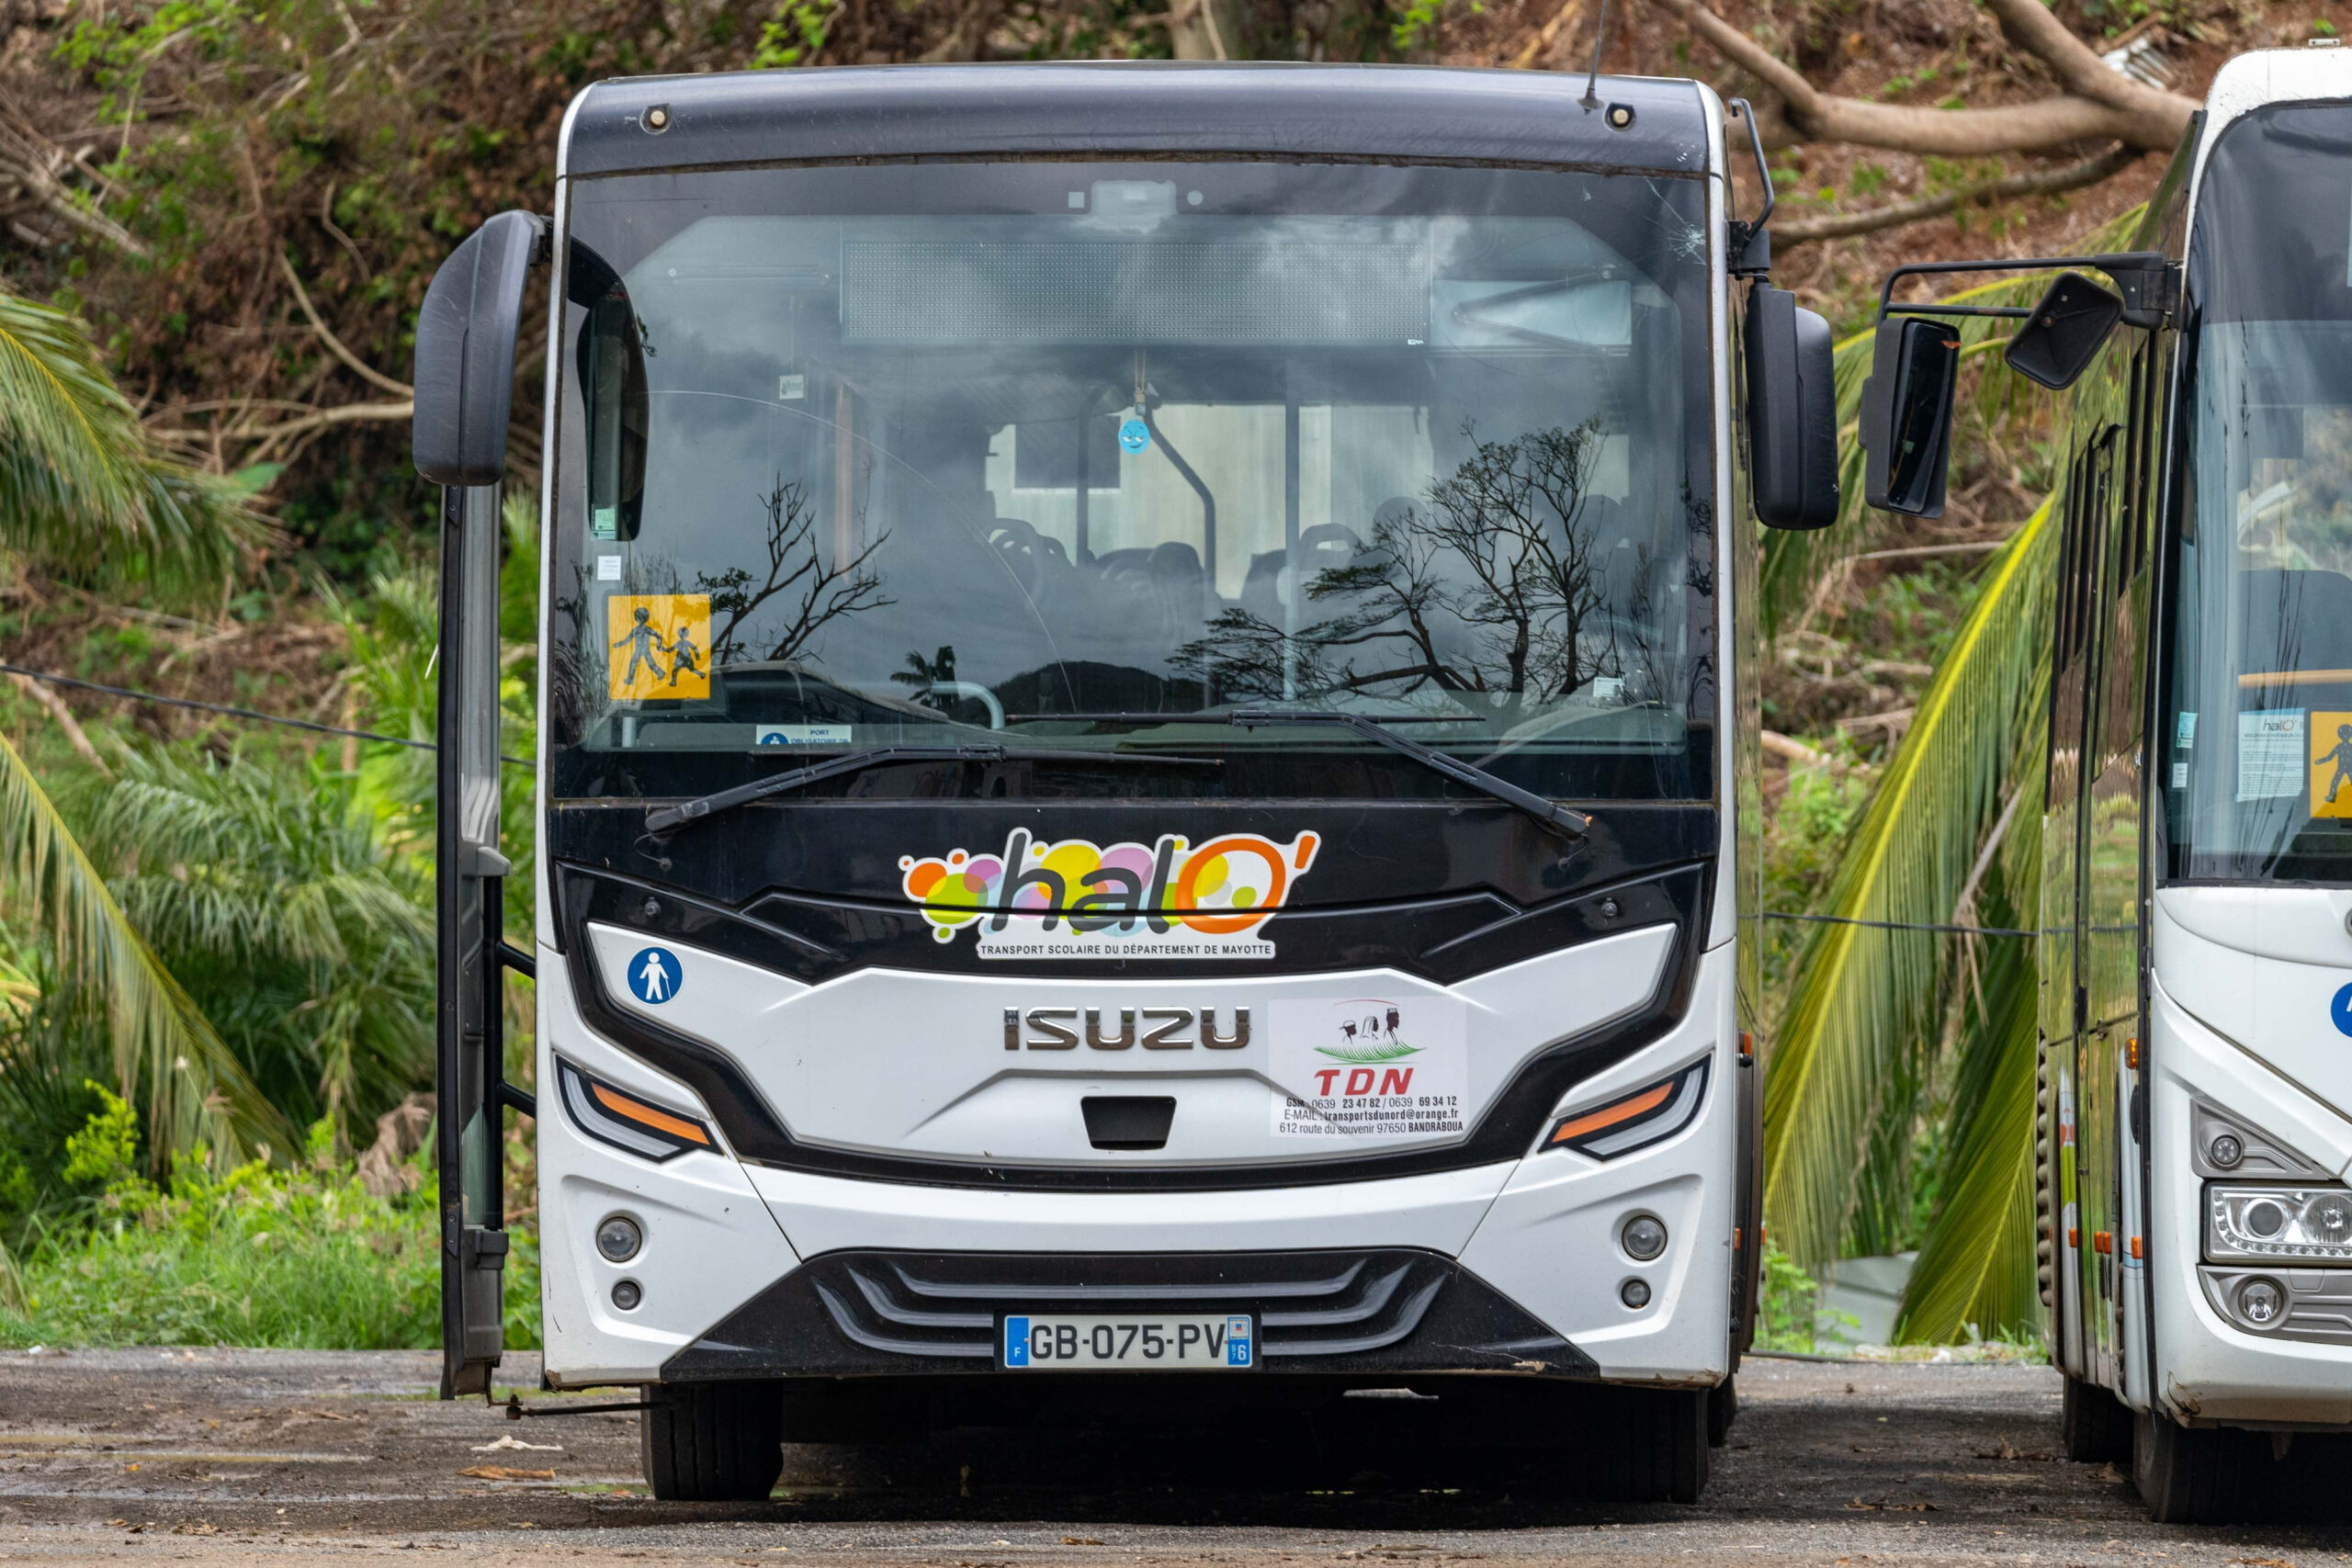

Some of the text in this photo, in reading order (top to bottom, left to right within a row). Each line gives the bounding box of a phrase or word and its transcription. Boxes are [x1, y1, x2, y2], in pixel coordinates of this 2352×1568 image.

[980, 942, 1272, 955] TRANSPORT SCOLAIRE DU DÉPARTEMENT DE MAYOTTE
[1004, 1006, 1250, 1051] ISUZU
[1314, 1067, 1414, 1097] TDN
[1311, 1098, 1336, 1109] 0639
[1342, 1098, 1355, 1109] 23
[1356, 1097, 1367, 1108] 47
[1369, 1097, 1380, 1108] 82
[1388, 1097, 1413, 1108] 0639
[1419, 1096, 1431, 1107] 69
[1432, 1096, 1444, 1107] 34
[1445, 1095, 1457, 1106] 12
[1284, 1109, 1317, 1121] E-MAIL
[1324, 1109, 1459, 1123] transportsdunord@orange.fr
[1279, 1121, 1464, 1134] 612 route du souvenir 97650 BANDRABOUA
[1030, 1324, 1226, 1359] GB-075-PV
[1014, 1347, 1022, 1358] F
